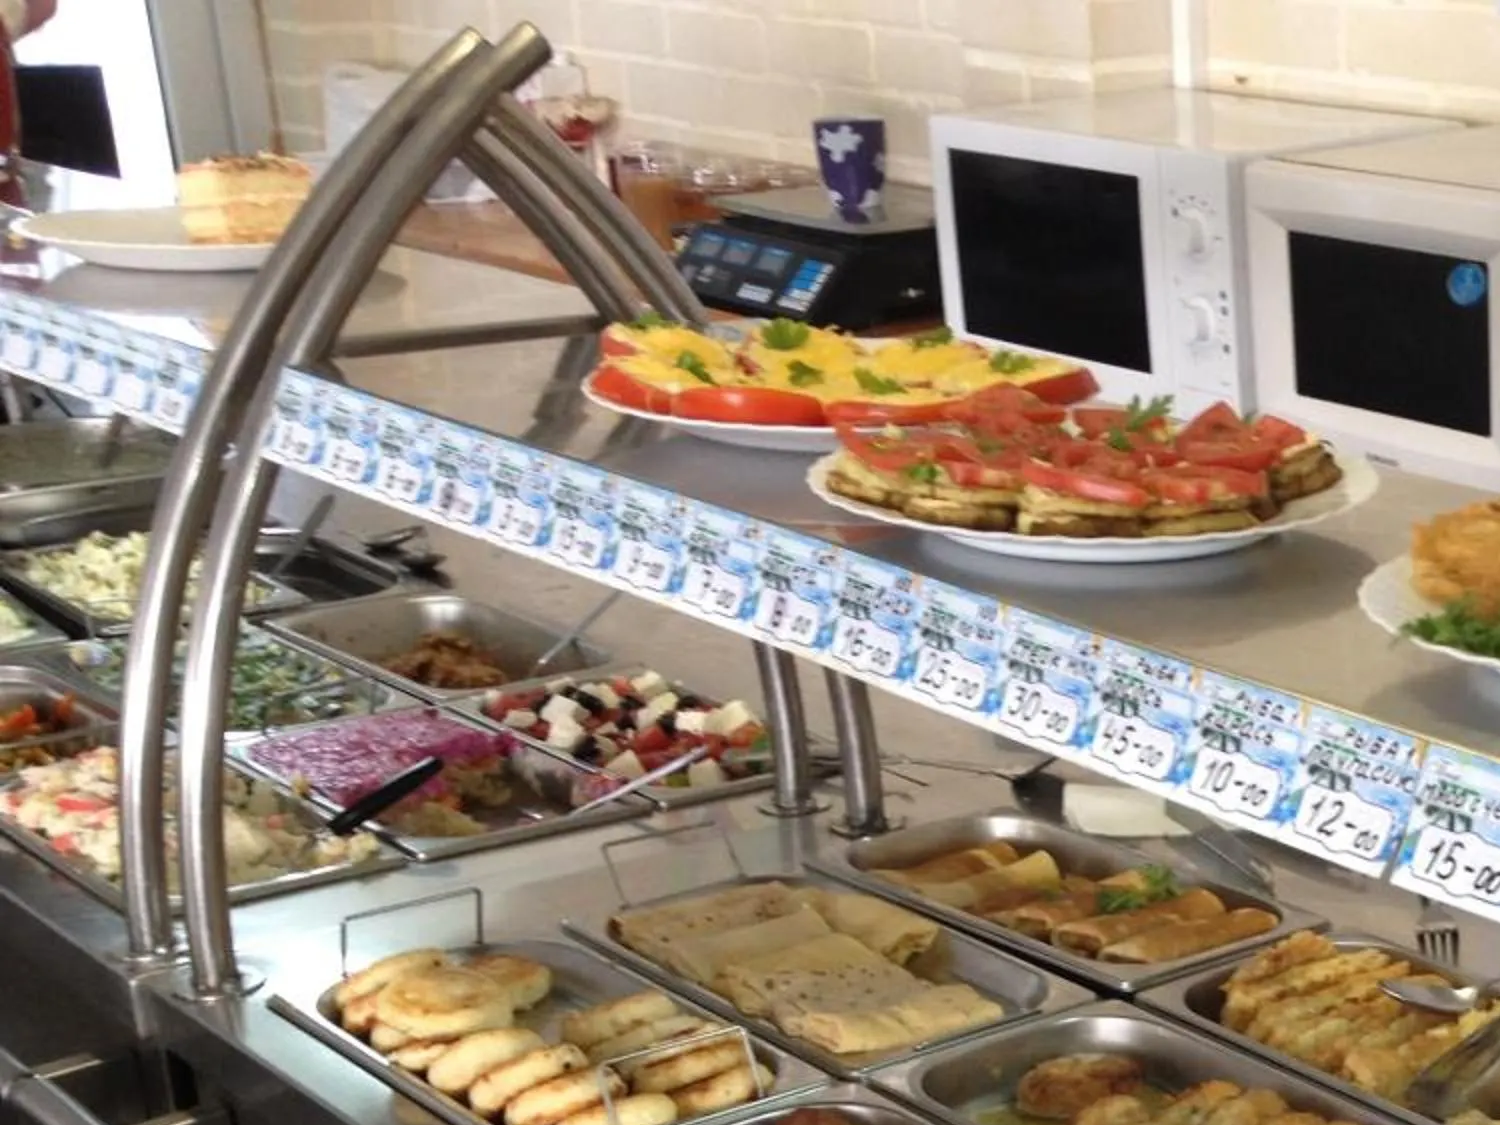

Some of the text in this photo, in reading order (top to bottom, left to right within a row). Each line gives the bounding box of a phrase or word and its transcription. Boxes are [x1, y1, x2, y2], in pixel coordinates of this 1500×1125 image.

[920, 651, 980, 700] 25-00
[1008, 685, 1070, 733] 30-00
[1102, 717, 1165, 768] 45-00
[1199, 758, 1268, 808] 10-00
[1304, 795, 1380, 853] 12-00
